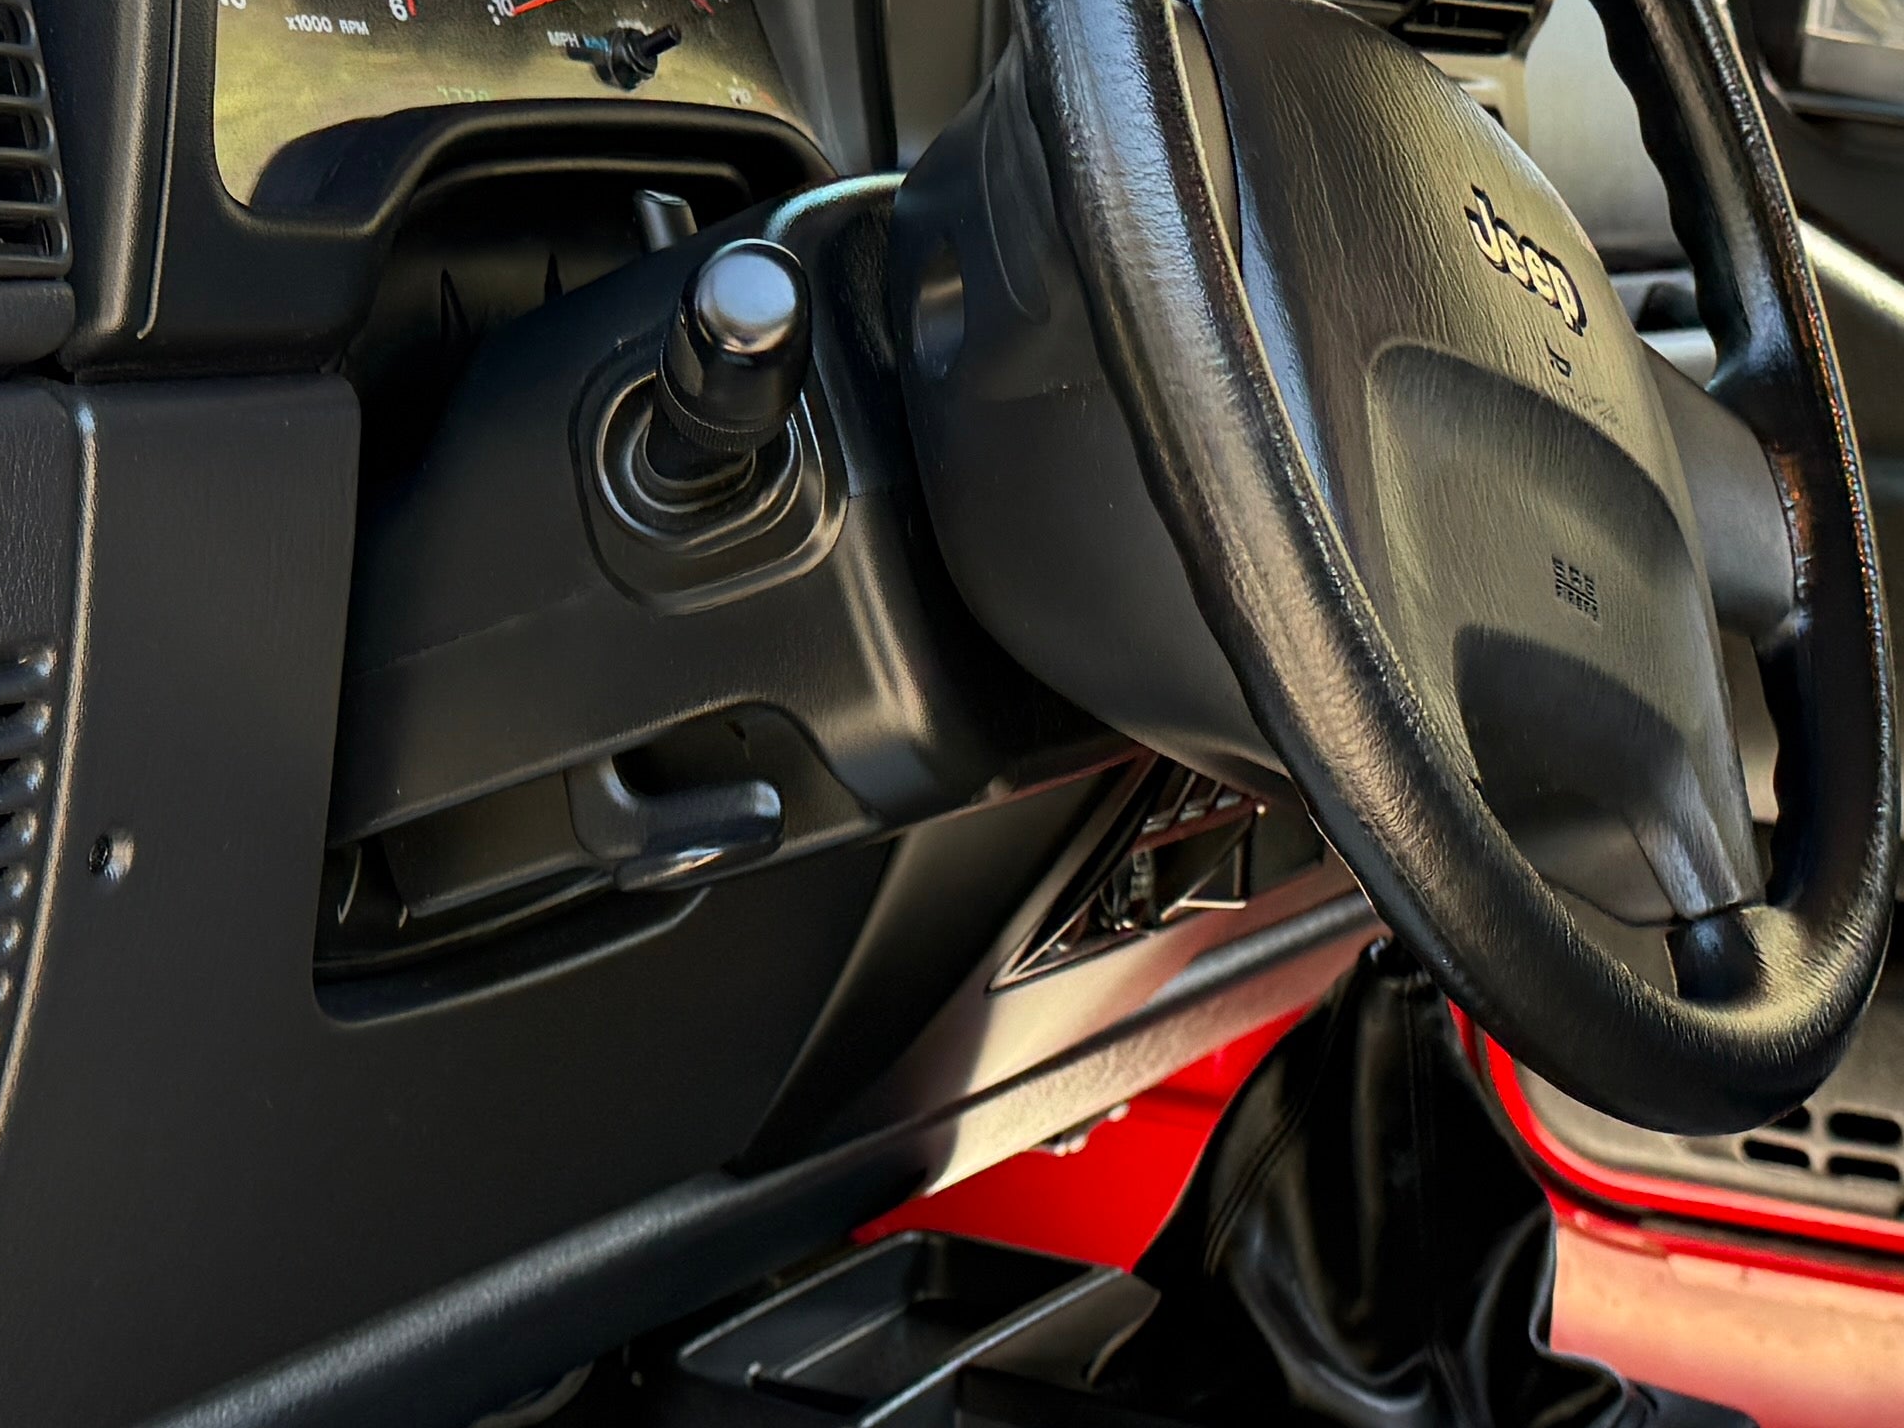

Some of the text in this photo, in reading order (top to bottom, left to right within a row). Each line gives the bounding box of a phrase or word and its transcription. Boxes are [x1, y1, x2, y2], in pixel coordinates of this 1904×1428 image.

[339, 19, 370, 36] RPM
[547, 31, 580, 48] MPH
[1464, 183, 1587, 337] Jeep
